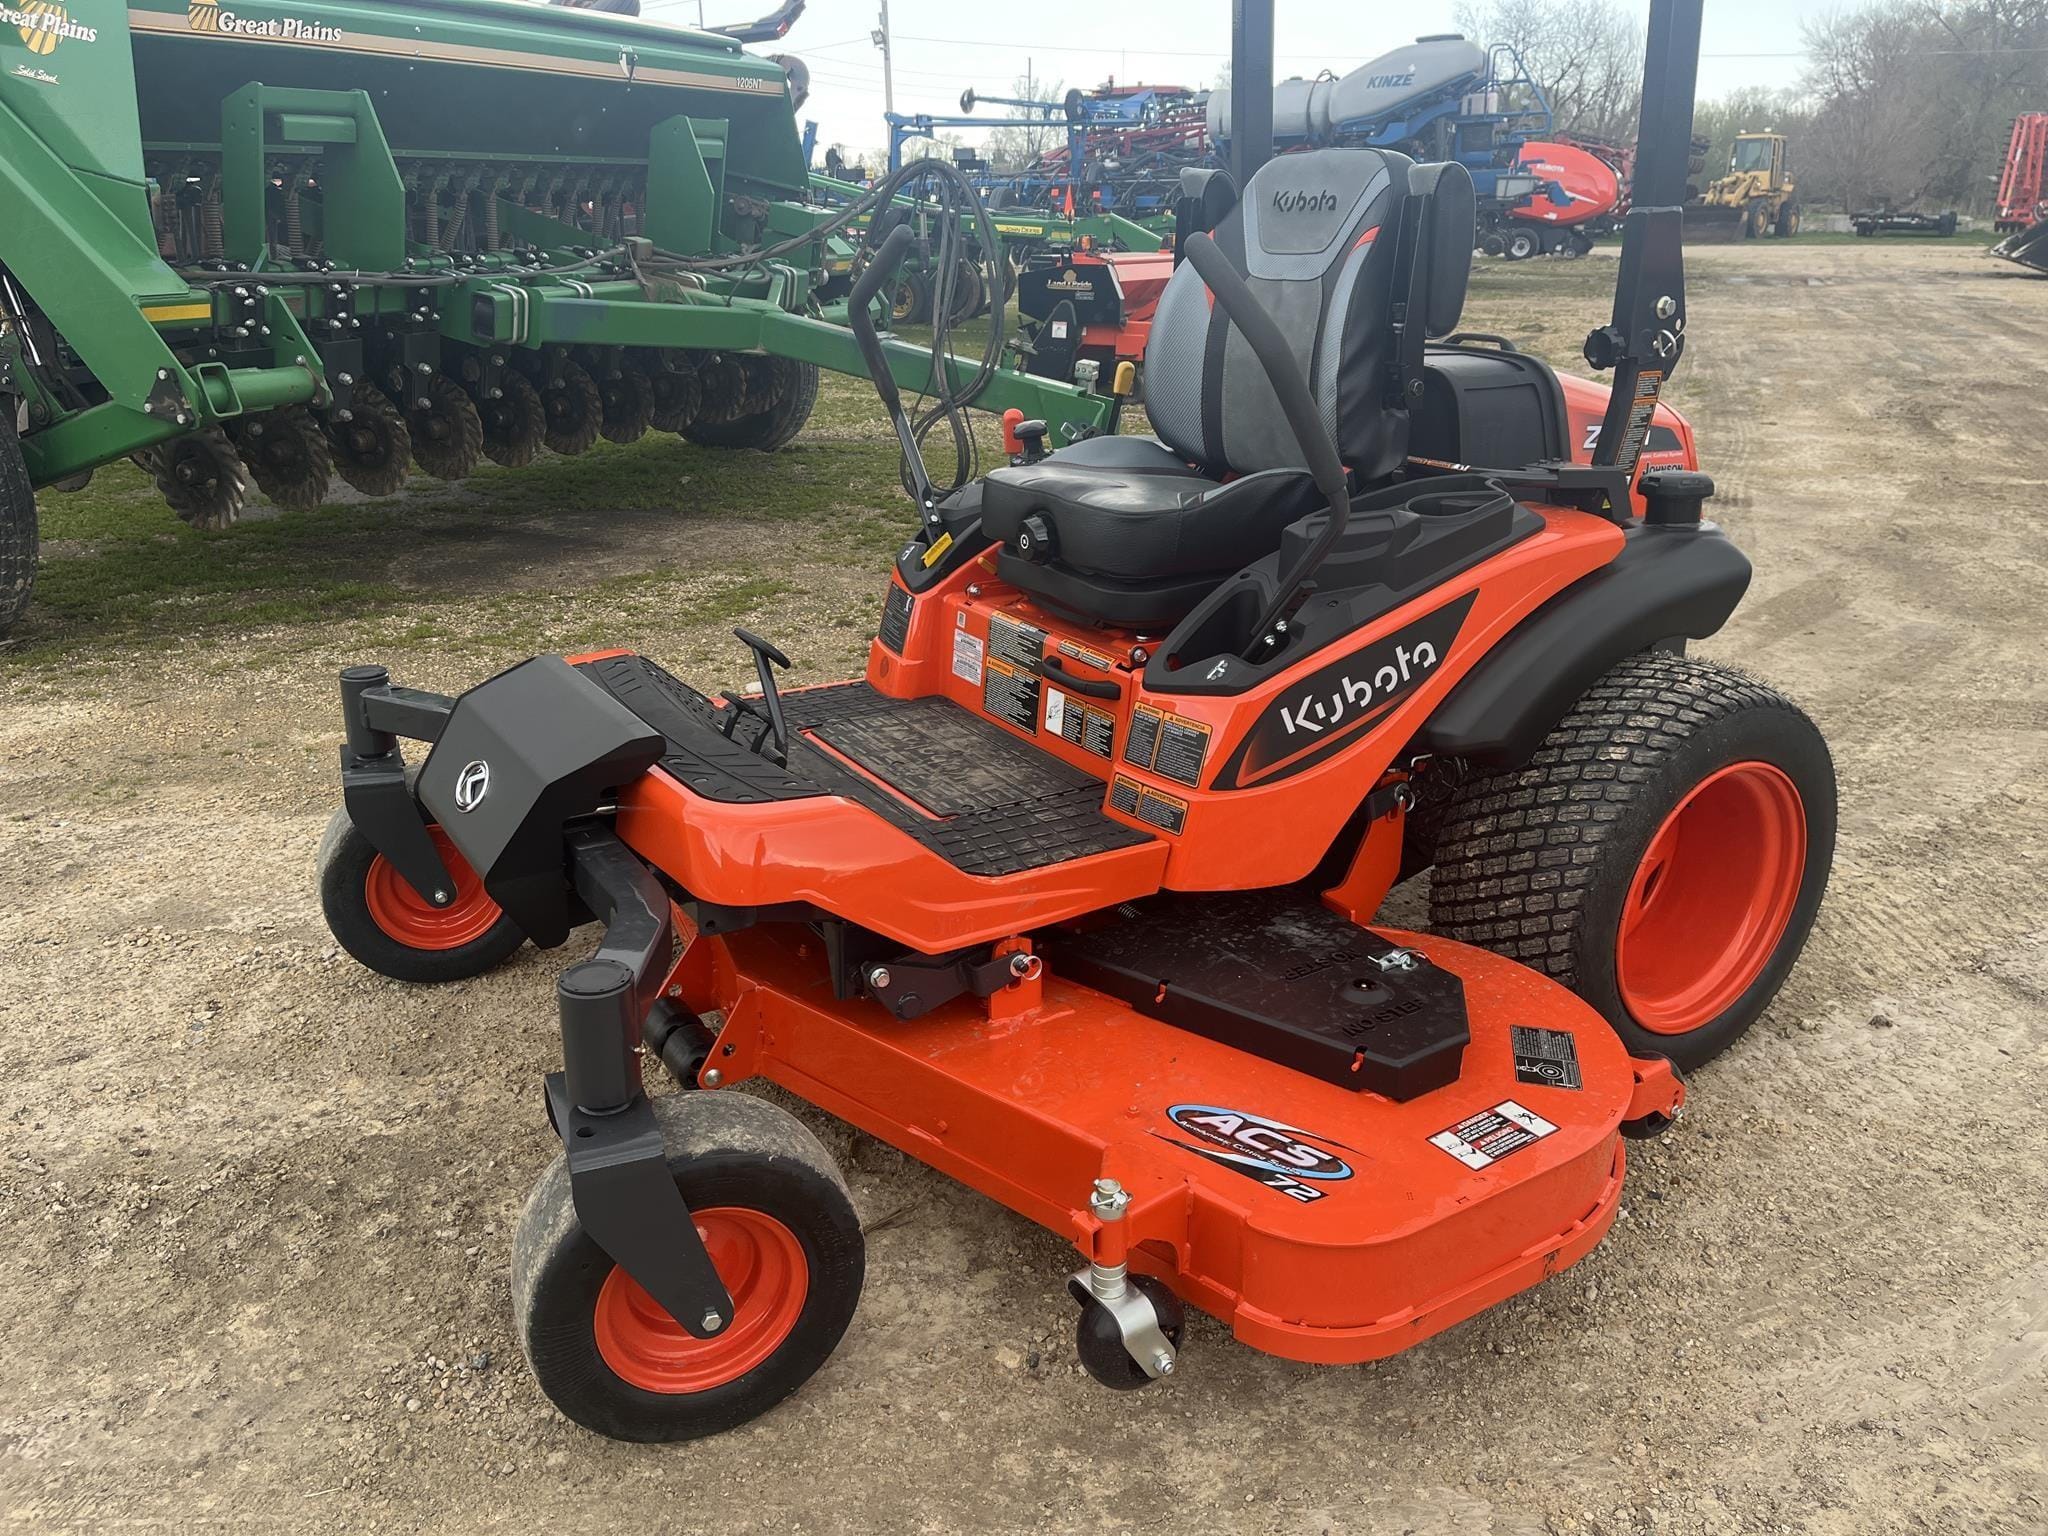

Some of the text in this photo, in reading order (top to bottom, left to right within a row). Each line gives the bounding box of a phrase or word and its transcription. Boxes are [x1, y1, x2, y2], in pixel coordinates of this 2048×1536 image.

[41, 12, 97, 42] Plains
[218, 11, 342, 42] Great Plains
[1366, 73, 1416, 89] KINZE
[1272, 189, 1338, 213] Kubota
[1279, 640, 1438, 735] Kubota
[1461, 1111, 1492, 1127] DANGER
[1188, 1113, 1335, 1168] ACS
[1481, 1125, 1516, 1143] PELIGRO
[1232, 1142, 1267, 1161] Cutting
[1263, 1173, 1322, 1202] 72
